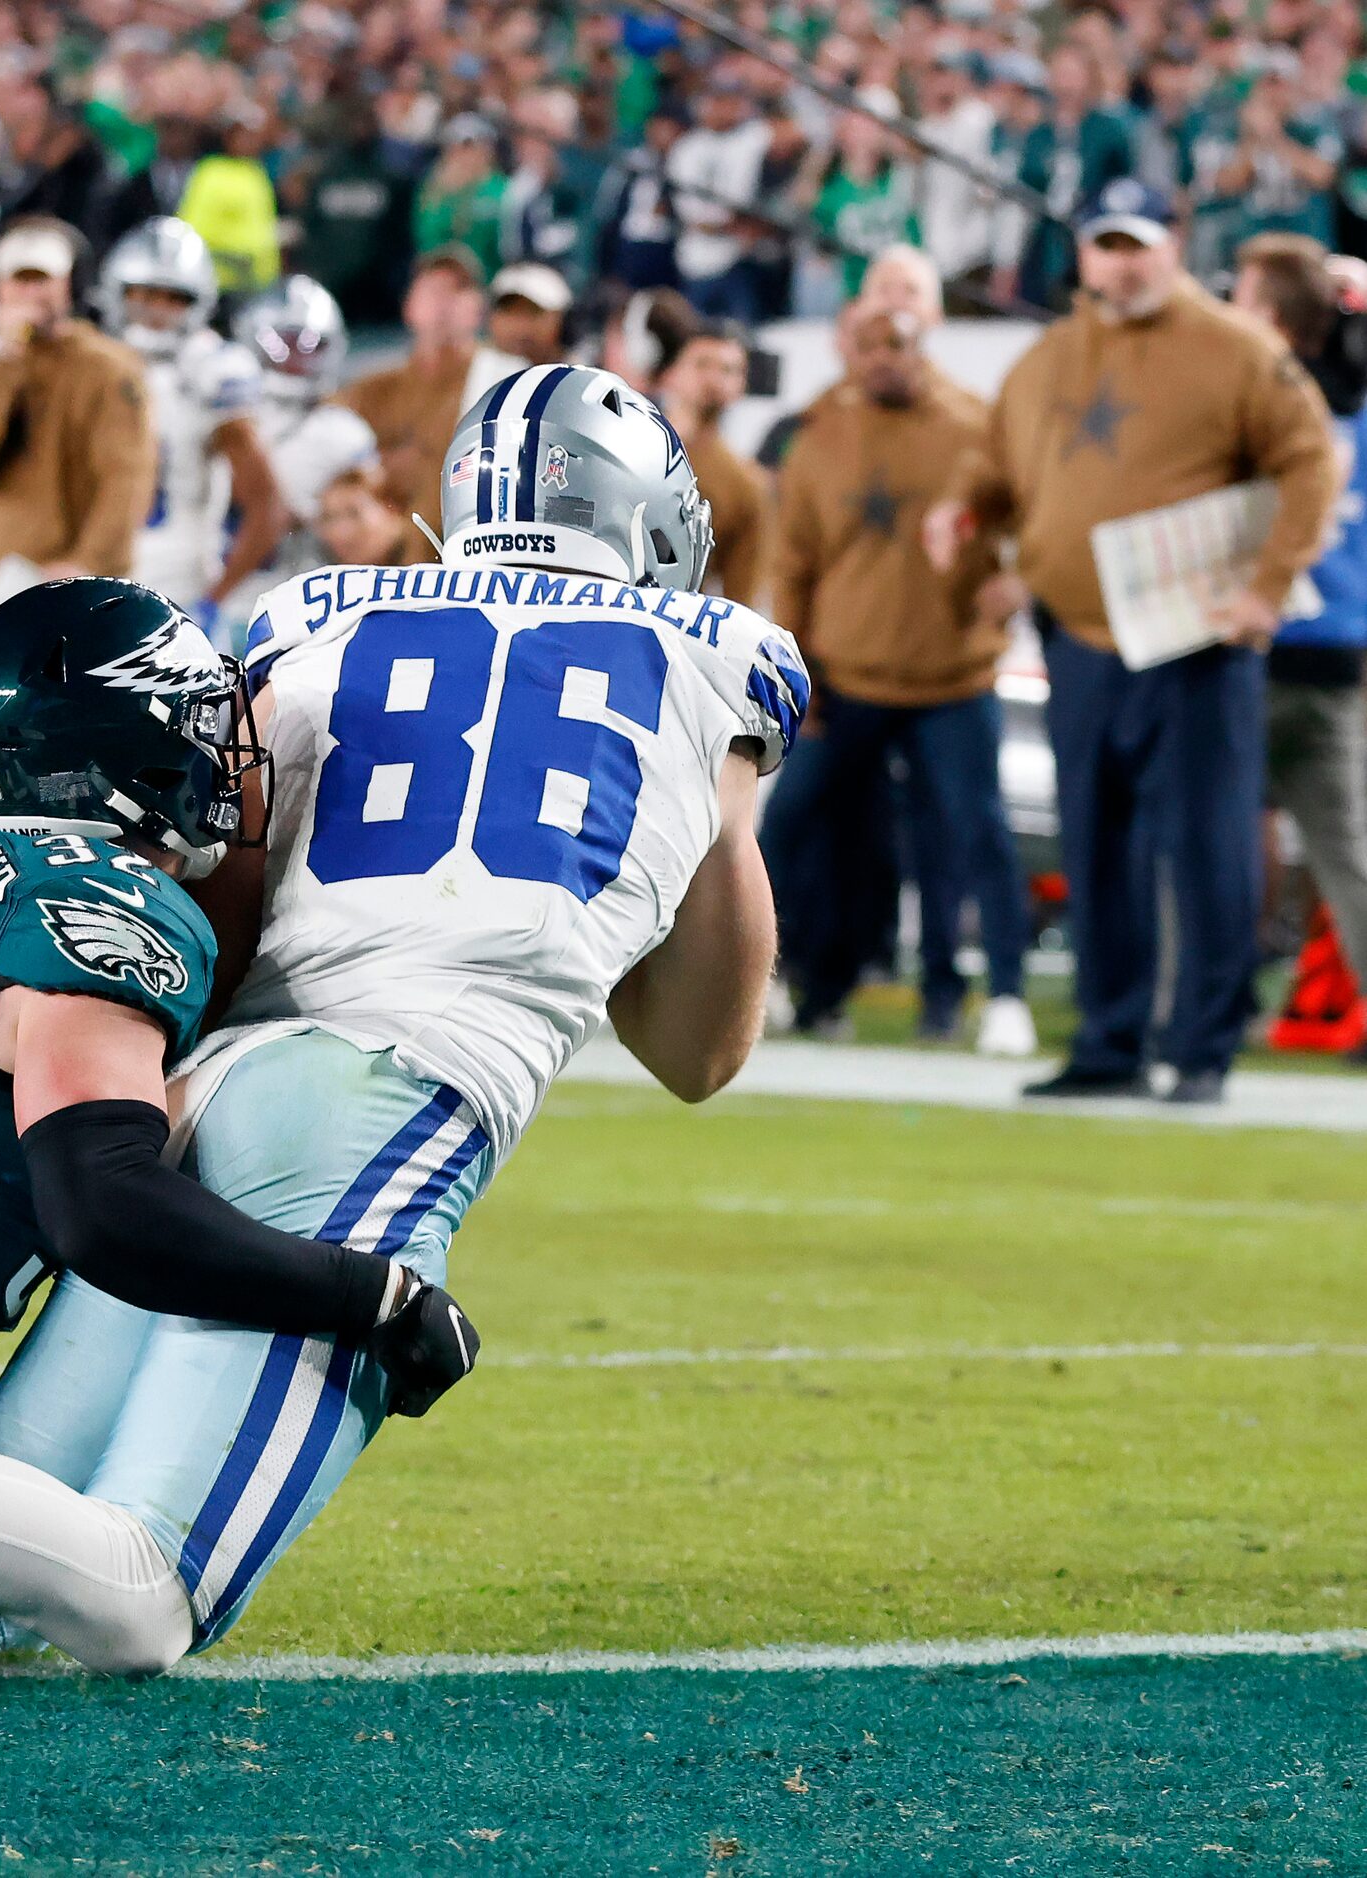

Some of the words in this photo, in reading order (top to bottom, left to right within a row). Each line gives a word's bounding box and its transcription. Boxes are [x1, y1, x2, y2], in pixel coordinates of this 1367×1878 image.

[463, 533, 556, 557] COWBOYS
[302, 567, 734, 648] SCHOONMAKER
[306, 607, 670, 905] 86
[33, 833, 161, 892] 32
